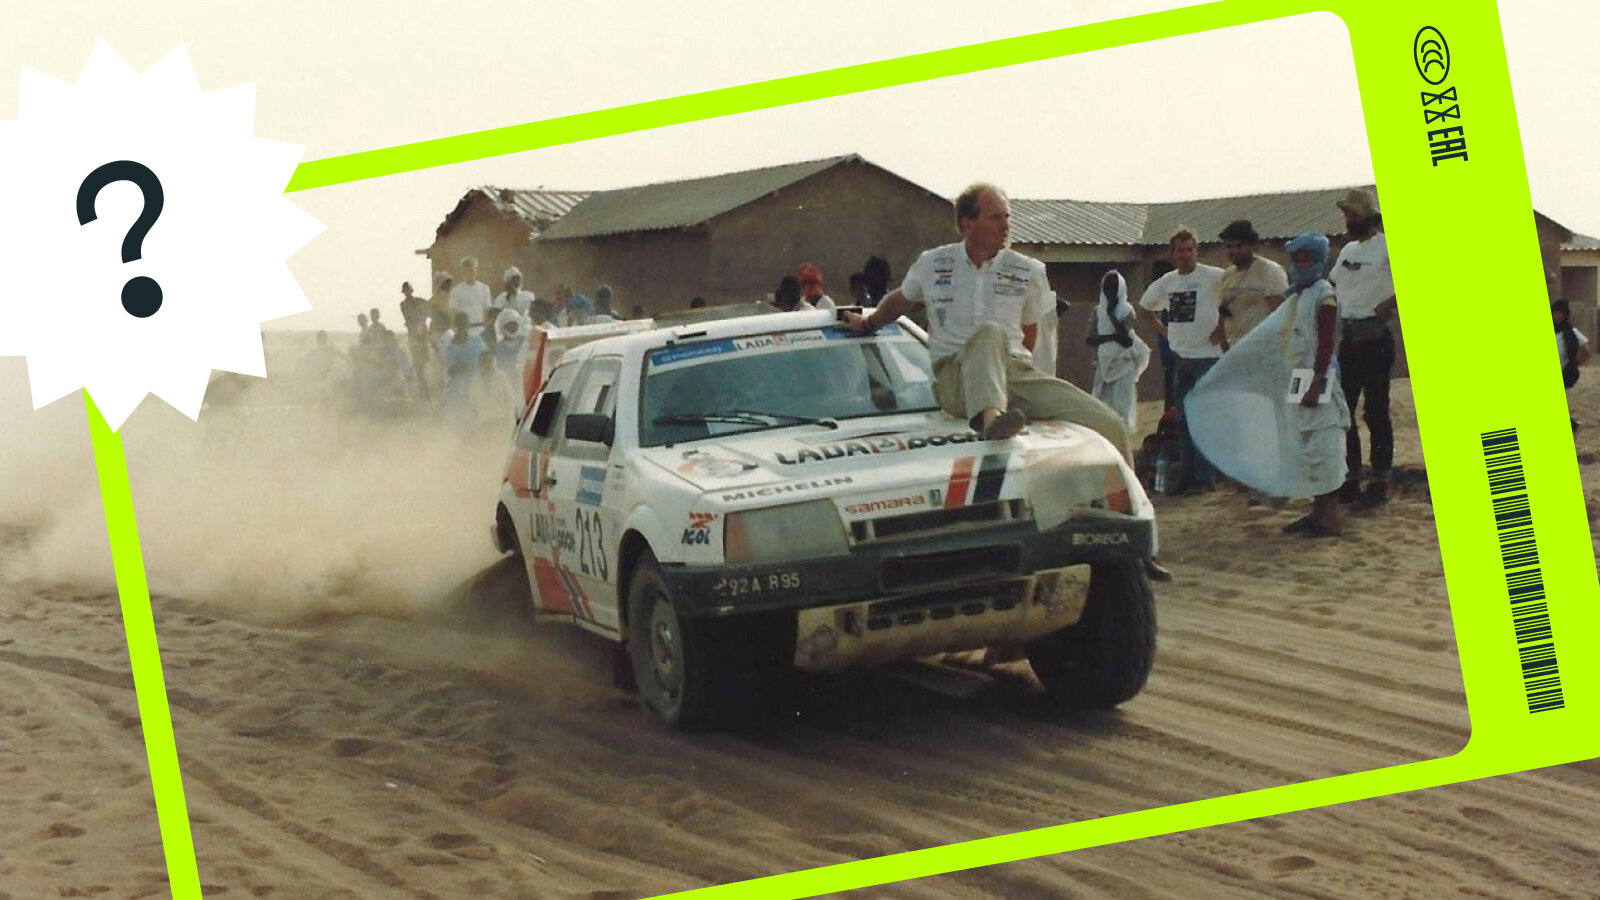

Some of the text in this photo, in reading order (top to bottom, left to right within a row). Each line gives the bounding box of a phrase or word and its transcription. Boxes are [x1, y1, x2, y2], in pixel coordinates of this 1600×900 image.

[736, 338, 773, 351] LADA
[775, 443, 870, 465] LADA
[722, 476, 854, 502] MICHELIN
[575, 507, 608, 581] 213
